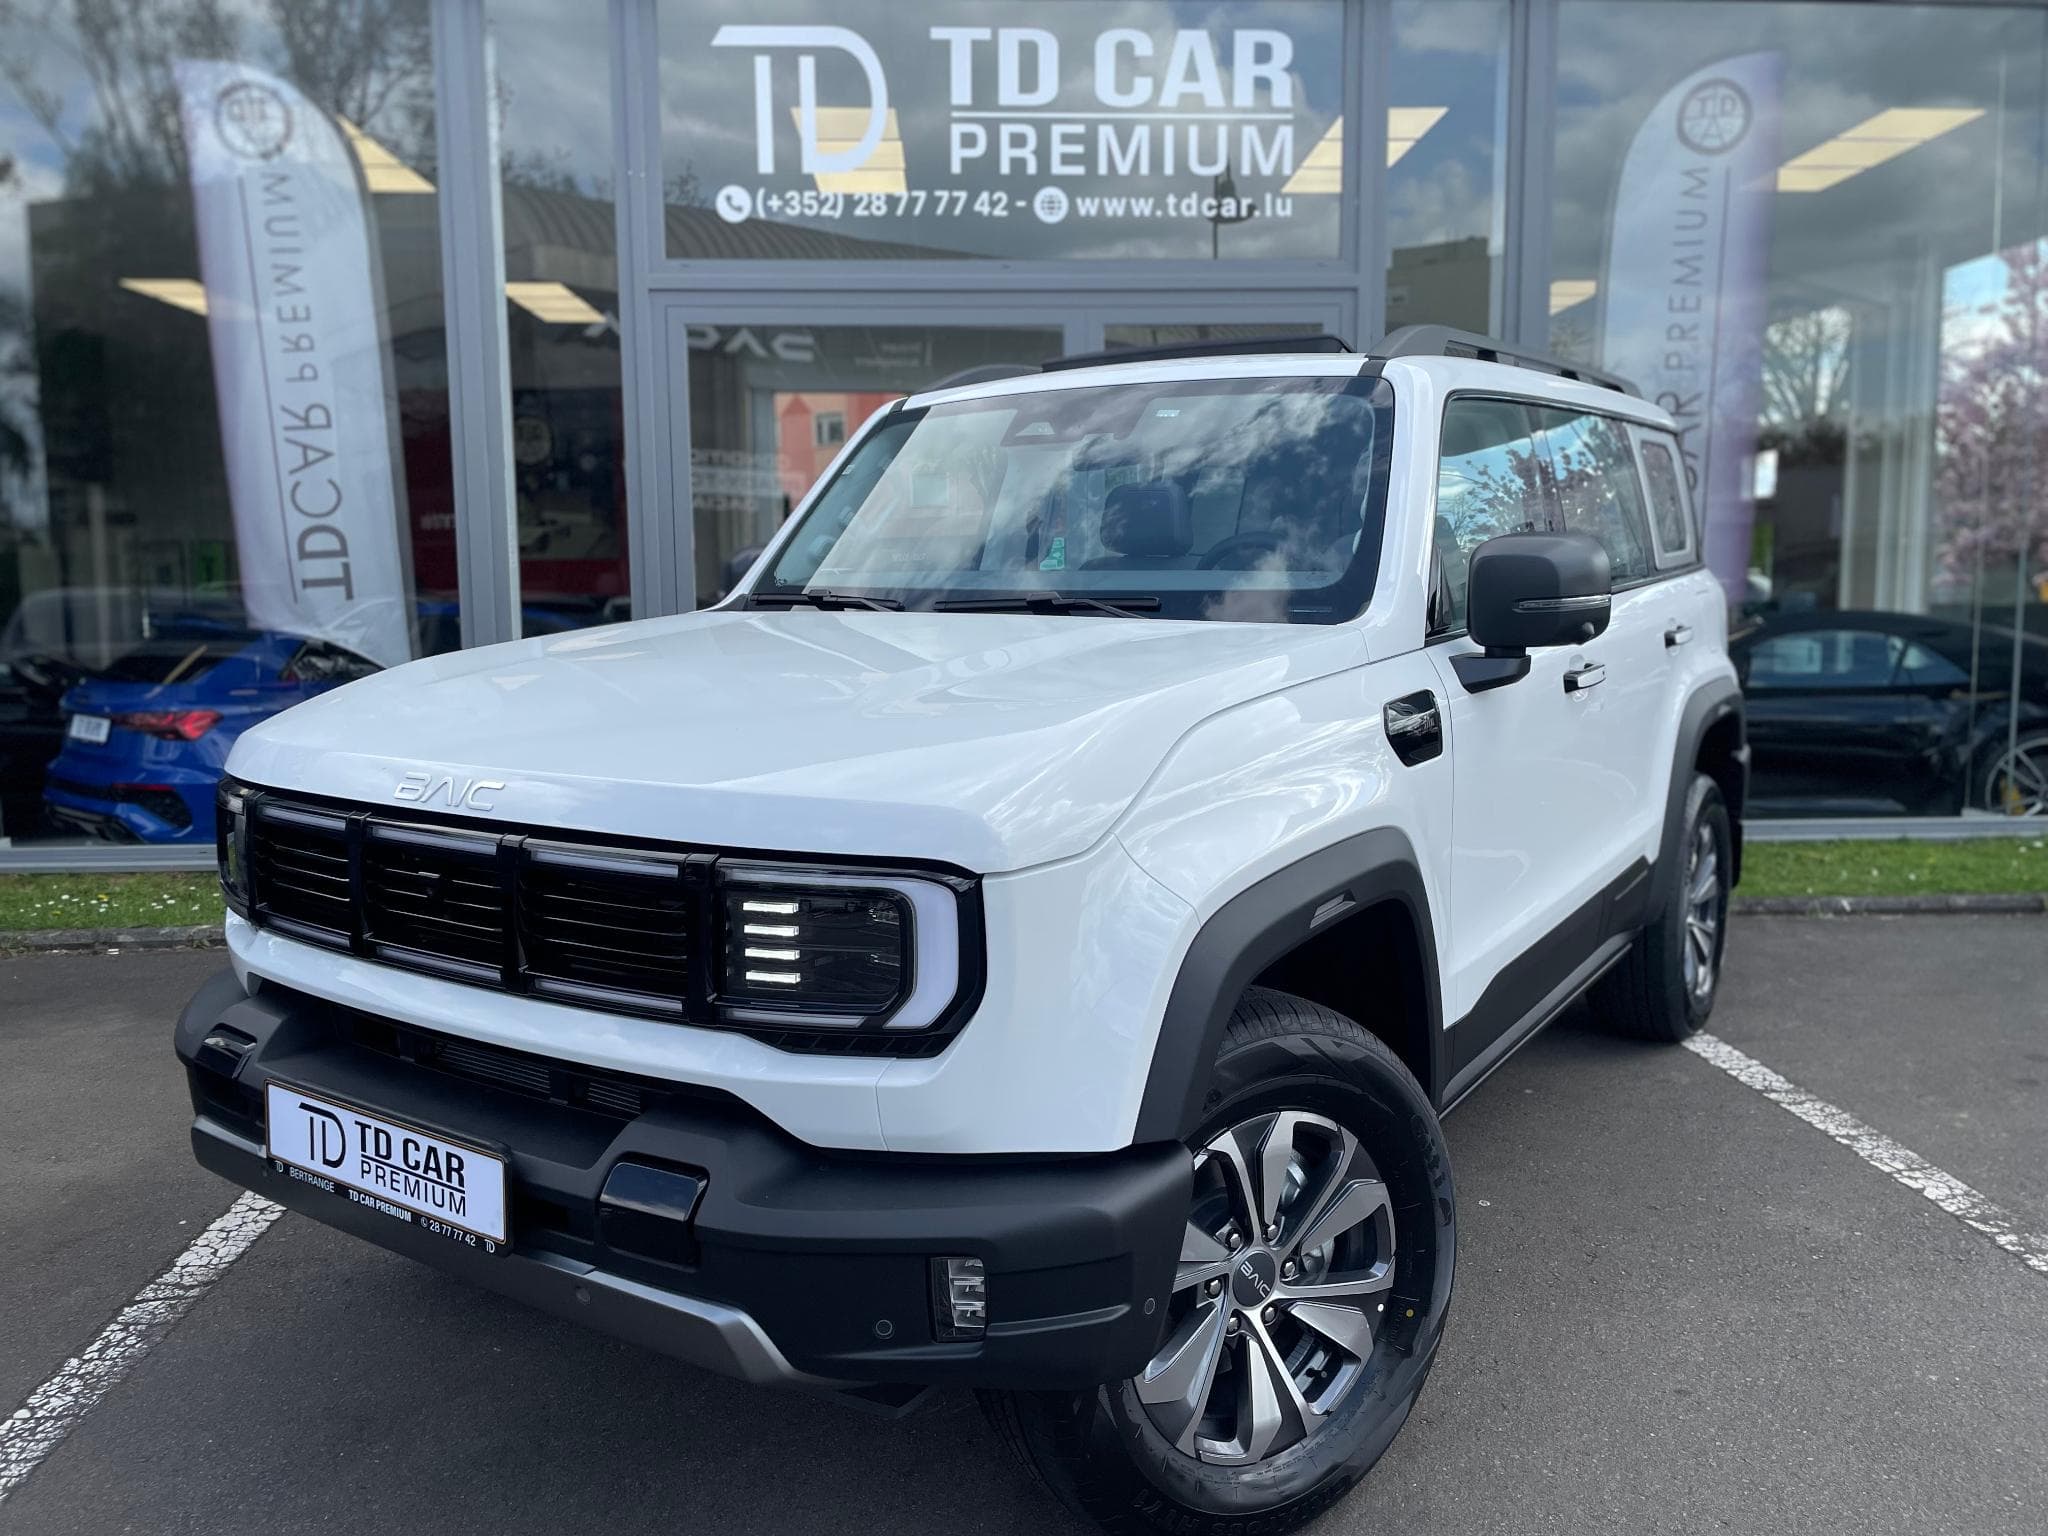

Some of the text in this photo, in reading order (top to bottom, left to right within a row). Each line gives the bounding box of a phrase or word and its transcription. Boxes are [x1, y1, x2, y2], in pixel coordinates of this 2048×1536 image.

[711, 25, 888, 175] TD
[930, 27, 1294, 107] TD CAR
[950, 123, 1294, 176] PREMIUM
[756, 187, 845, 218] (+352)
[853, 191, 888, 217] 28
[893, 191, 927, 217] 77
[933, 191, 968, 217] 77
[973, 191, 1009, 217] 42
[1075, 192, 1293, 218] www.tdcar.lu
[1664, 166, 1710, 372] PREMIUM
[394, 771, 506, 812] BAIC
[298, 1101, 346, 1169] TD
[354, 1120, 465, 1188] TD CAR
[289, 1166, 335, 1193] BERTRANGE
[348, 1189, 359, 1202] TD
[360, 1195, 375, 1208] CAR
[375, 1201, 412, 1223] PREMIUM
[429, 1220, 440, 1233] 28
[441, 1224, 452, 1237] 77
[453, 1228, 463, 1241] 77
[465, 1233, 476, 1247] 42
[360, 1159, 466, 1217] PREMIUM
[1240, 1260, 1271, 1298] BAIC
